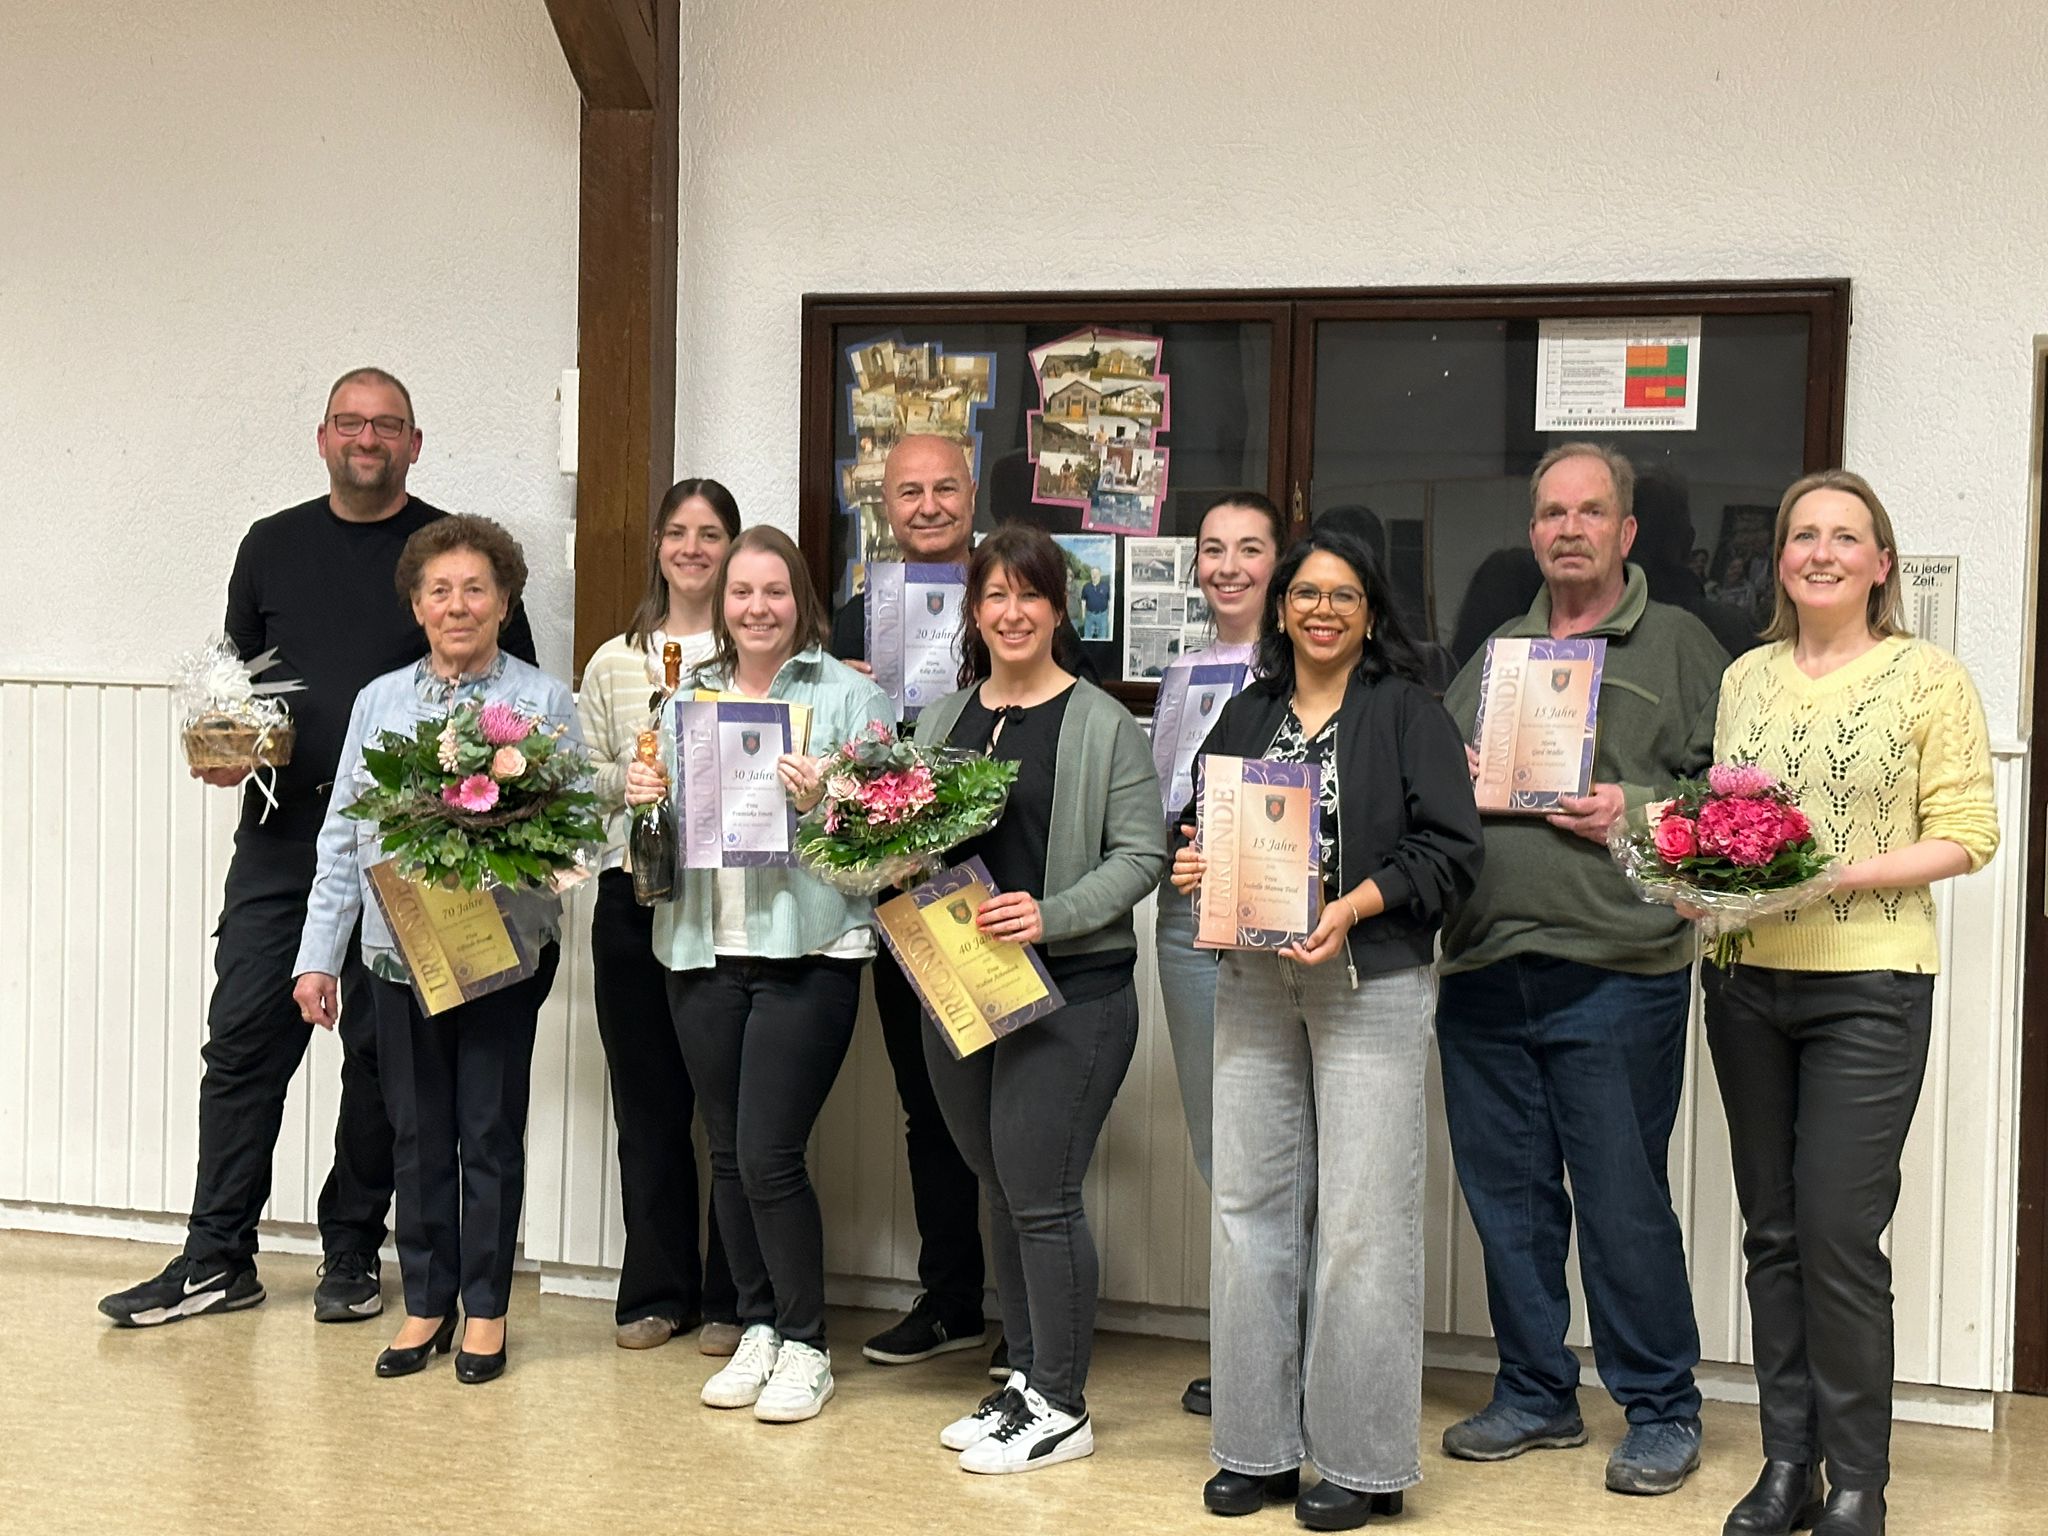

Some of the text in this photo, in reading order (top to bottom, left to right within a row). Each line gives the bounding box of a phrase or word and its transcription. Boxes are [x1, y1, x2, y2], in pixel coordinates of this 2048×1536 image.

[1902, 562, 1918, 574] Zu
[1912, 575, 1935, 587] Zeit
[915, 629, 928, 639] 20
[1533, 706, 1578, 719] 15 Jahre
[1485, 665, 1520, 786] URKUNDE
[733, 768, 775, 782] 30 Jahre
[691, 728, 717, 846] URKUNDE
[1251, 837, 1298, 853] 15 Jahre
[1208, 788, 1235, 920] URKUNDE
[442, 907, 455, 920] 70
[457, 898, 483, 916] Jahre
[959, 942, 972, 955] 40
[901, 920, 977, 1035] URKUNDE
